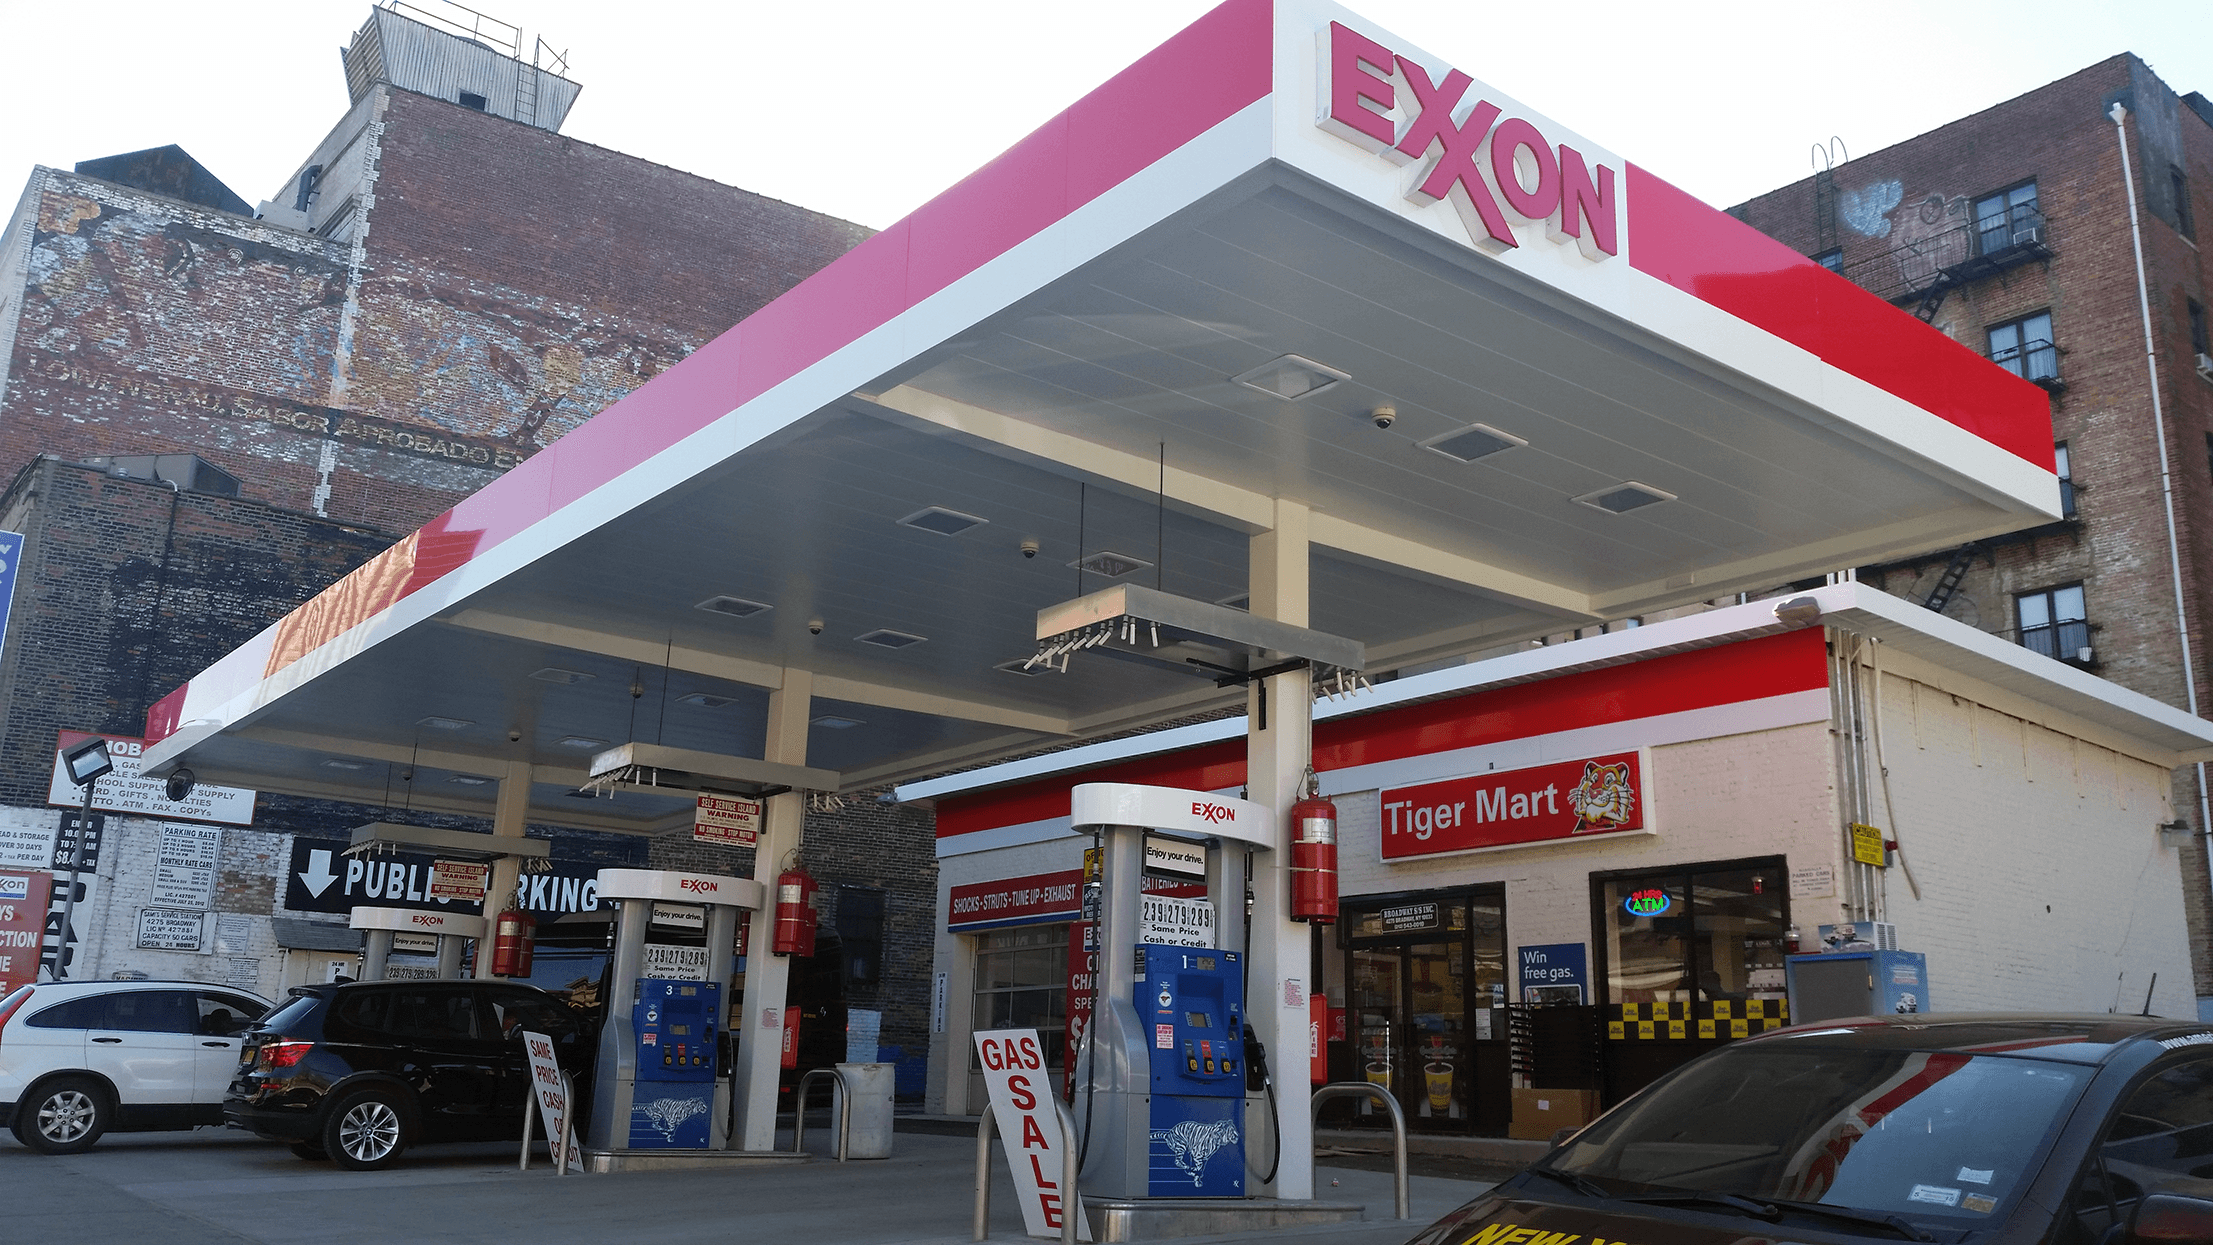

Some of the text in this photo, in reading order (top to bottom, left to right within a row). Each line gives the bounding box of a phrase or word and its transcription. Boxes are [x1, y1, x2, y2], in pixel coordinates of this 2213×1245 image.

[1328, 19, 1618, 257] EXXON
[334, 418, 490, 465] APROBADO
[82, 786, 212, 806] CRD GIFTS NOELTIES
[198, 790, 236, 800] SUPPLY
[80, 796, 113, 805] LTTO
[152, 803, 171, 811] FAX
[702, 798, 714, 807] SELF
[716, 800, 736, 811] SERVICE
[707, 810, 749, 821] WARNING
[1192, 802, 1235, 824] EXXON
[1384, 783, 1559, 840] Tiger Mart
[165, 827, 216, 839] PARKING RATE
[160, 857, 184, 866] MONTHLY
[1147, 846, 1203, 865] Enjoy your drive.
[345, 858, 451, 905] PUBLI
[681, 879, 718, 894] EXXON
[954, 896, 980, 914] SHOCKS
[983, 892, 1008, 911] STRUTS
[1012, 890, 1029, 907] TUNE
[1030, 888, 1040, 905] UP
[1044, 884, 1076, 903] EXHAUST
[1633, 898, 1663, 912] ATM
[654, 910, 670, 919] Enjoy
[1384, 908, 1413, 918] BROADWAY
[412, 915, 444, 927] EXXON
[1151, 924, 1199, 936] Same Price
[1144, 935, 1165, 944] Cash
[1181, 938, 1206, 948] Credit
[1182, 955, 1188, 969] 1
[1524, 950, 1547, 964] Win
[1525, 966, 1574, 982] free gas.
[666, 985, 673, 995] 3
[530, 1039, 552, 1060] SAME
[982, 1037, 1040, 1071] GAS
[535, 1065, 559, 1086] PRICE
[543, 1090, 563, 1110] CASH
[1008, 1075, 1062, 1229] SALE
